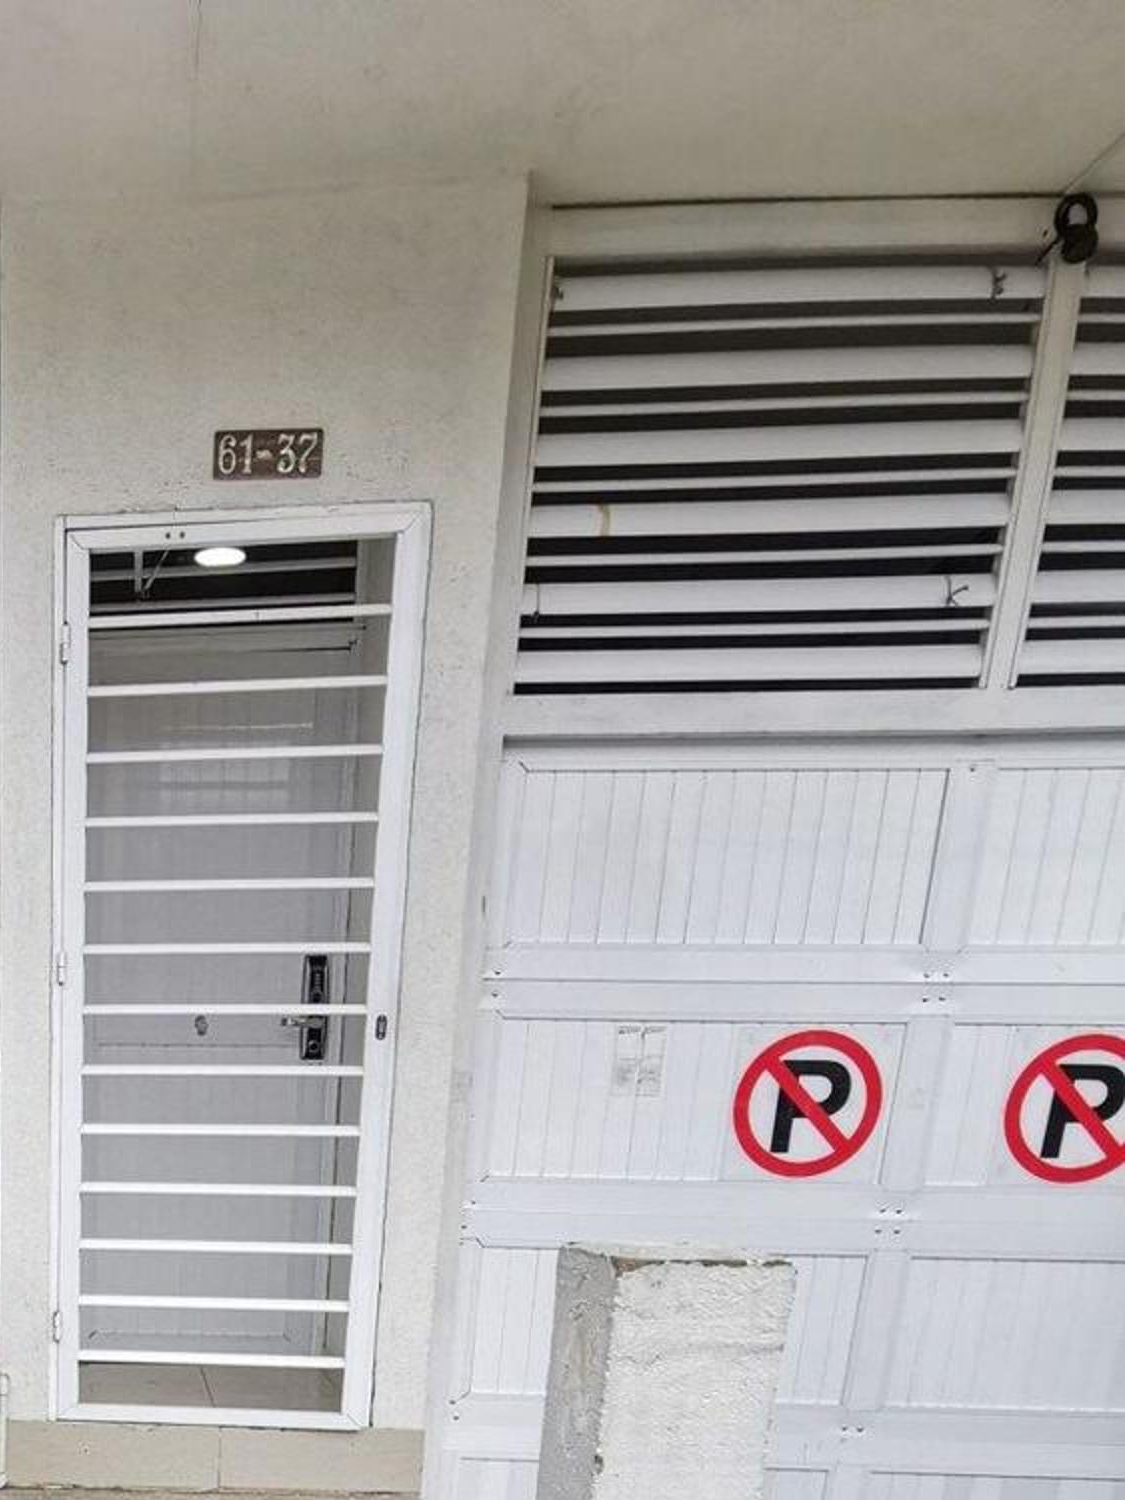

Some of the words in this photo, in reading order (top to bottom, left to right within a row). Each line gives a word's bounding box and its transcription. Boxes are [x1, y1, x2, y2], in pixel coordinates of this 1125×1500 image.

[218, 432, 318, 475] 61-37
[770, 1059, 852, 1154] P
[1040, 1063, 1125, 1159] P
